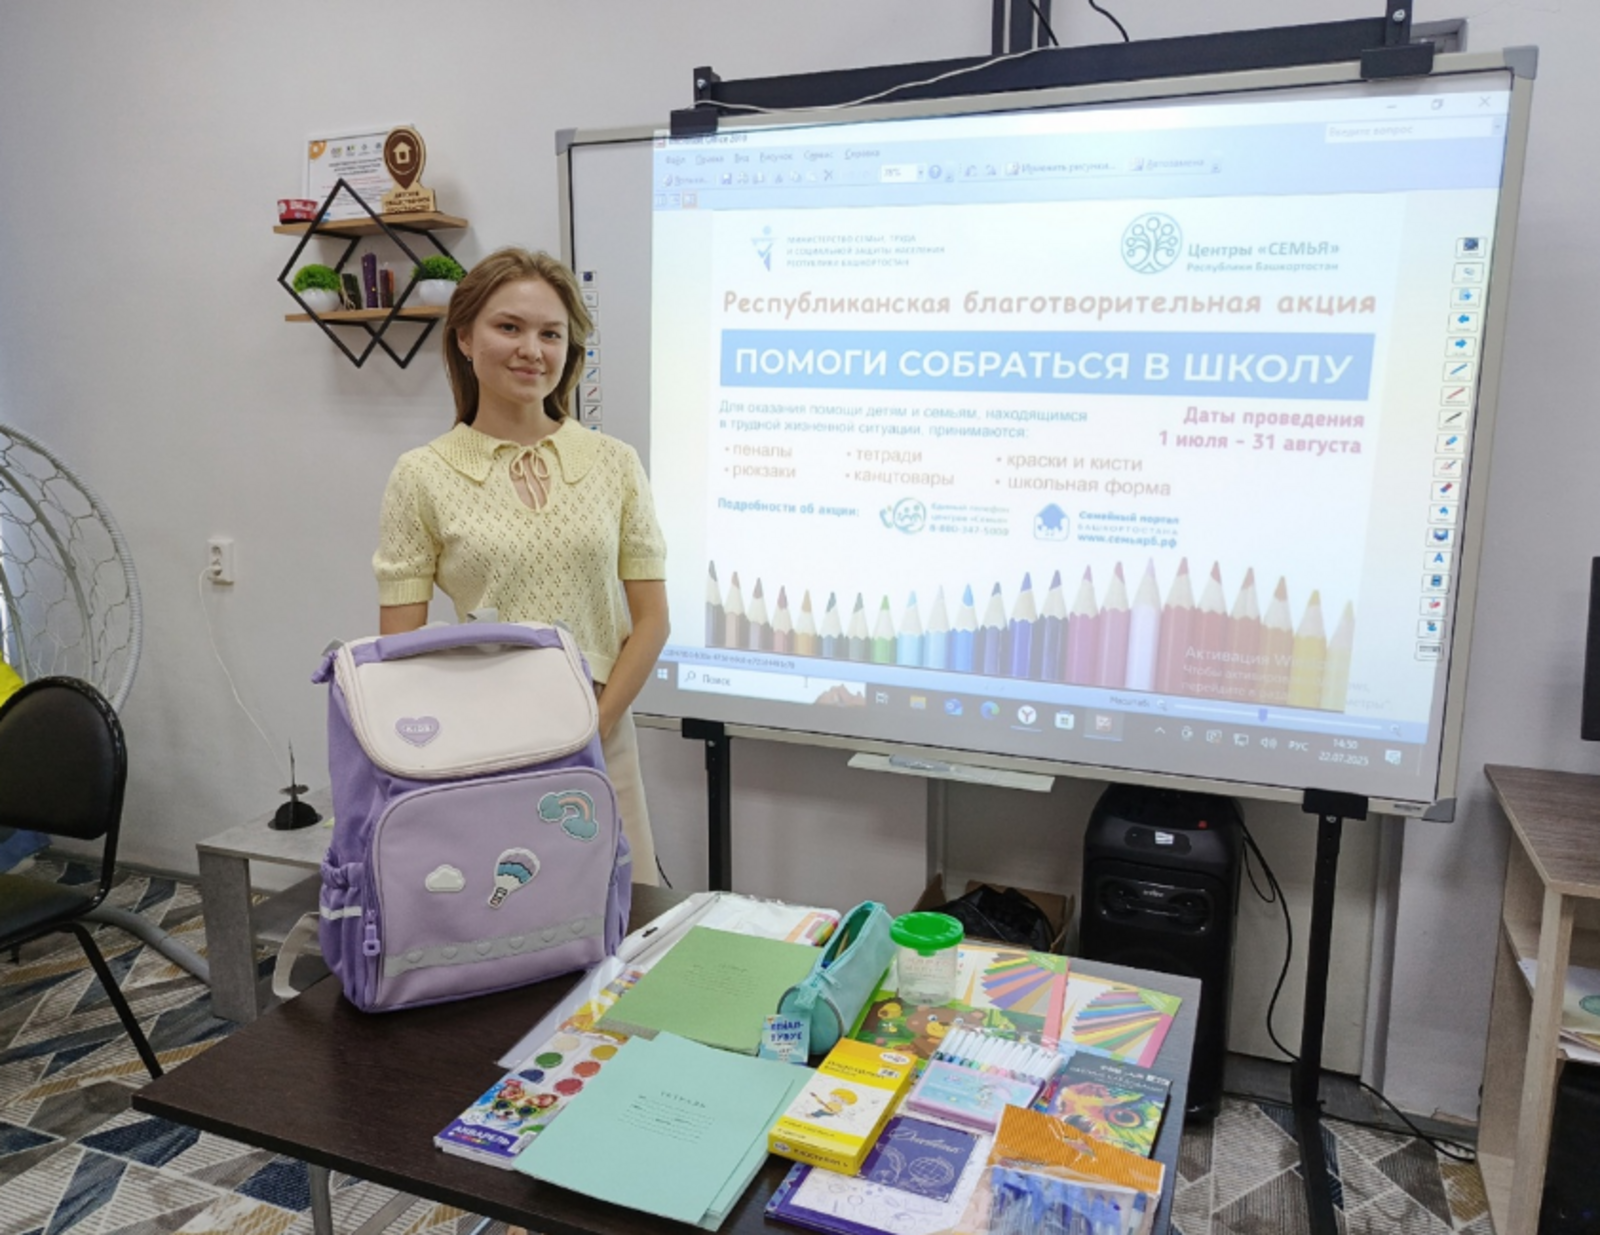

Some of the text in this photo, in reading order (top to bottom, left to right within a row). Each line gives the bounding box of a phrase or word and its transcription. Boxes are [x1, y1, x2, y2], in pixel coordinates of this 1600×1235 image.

[1374, 125, 1413, 136] вопрос
[786, 235, 853, 244] МИНИСТЕРСТВО
[890, 234, 917, 243] ТРУДА
[1187, 241, 1340, 259] Центры «СЕМЬЯ»
[841, 258, 910, 268] БАШКОРТОСТАН
[1186, 261, 1339, 274] Республики Башкортостан
[723, 290, 1376, 321] Республиканская благотворительная акция
[735, 348, 1354, 384] ПОМОГИ СОБРАТЬСЯ В ШКОЛУ
[719, 400, 1088, 423] Для оказания помощи детям и семьям, находящимся
[1183, 406, 1365, 429] Даты проведения
[719, 419, 727, 429] в
[730, 418, 781, 432] трудной
[784, 420, 854, 433] жизненной
[929, 425, 1029, 439] принимаются:
[732, 443, 793, 459] пеналы
[1159, 430, 1168, 446] 1
[1175, 433, 1228, 449] июля
[1252, 433, 1276, 451] 31
[1283, 437, 1362, 457] августа
[855, 448, 923, 464] тетради
[1006, 453, 1143, 472] краски и кисти
[732, 463, 796, 479] рюкзаки
[854, 469, 955, 488] канцтовары
[1008, 475, 1172, 498] школьная форма
[718, 497, 860, 517] Подробности об акции:
[1079, 510, 1180, 525] Семейный портал
[1184, 645, 1270, 667] Активация
[703, 674, 731, 686] Поиск
[1288, 740, 1309, 752] РУС
[1318, 751, 1370, 767] 22.07.2025
[451, 1125, 510, 1147] АКВАРЕЛЬ
